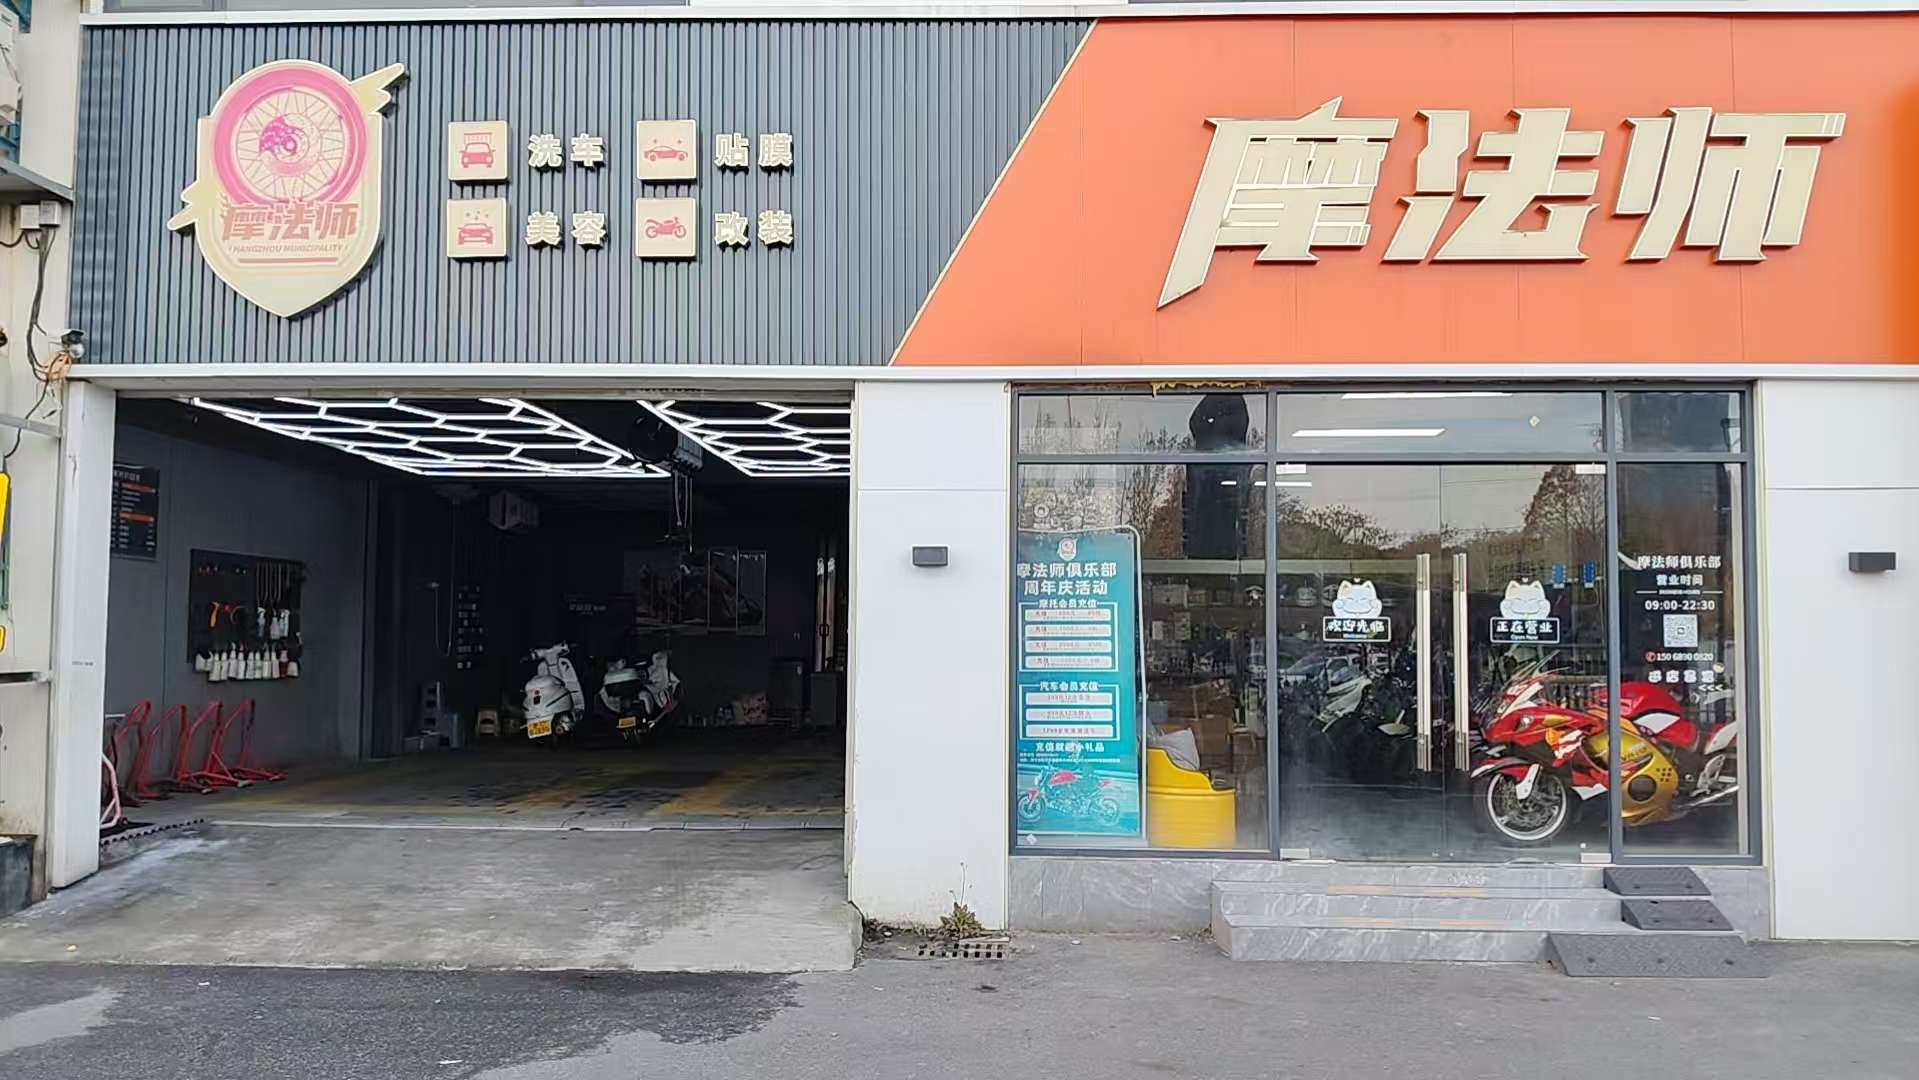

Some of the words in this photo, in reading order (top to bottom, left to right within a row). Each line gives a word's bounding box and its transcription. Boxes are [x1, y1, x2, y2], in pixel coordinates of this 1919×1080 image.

[528, 133, 603, 168] 洗车
[714, 133, 793, 168] 贴膜
[1156, 95, 1847, 310] 摩法师
[221, 200, 359, 240] 摩法师
[525, 210, 606, 245] 美容
[714, 210, 793, 245] 改装
[1638, 555, 1721, 569] 摩法师俱乐部
[1024, 580, 1108, 595] 周年庆活动
[1656, 574, 1703, 586] 营业时间
[1645, 600, 1715, 610] 09:00-22:30
[1328, 620, 1385, 632] 欢迎光临
[1496, 621, 1553, 634] 正在营业
[1040, 681, 1099, 691] 汽车会员充值
